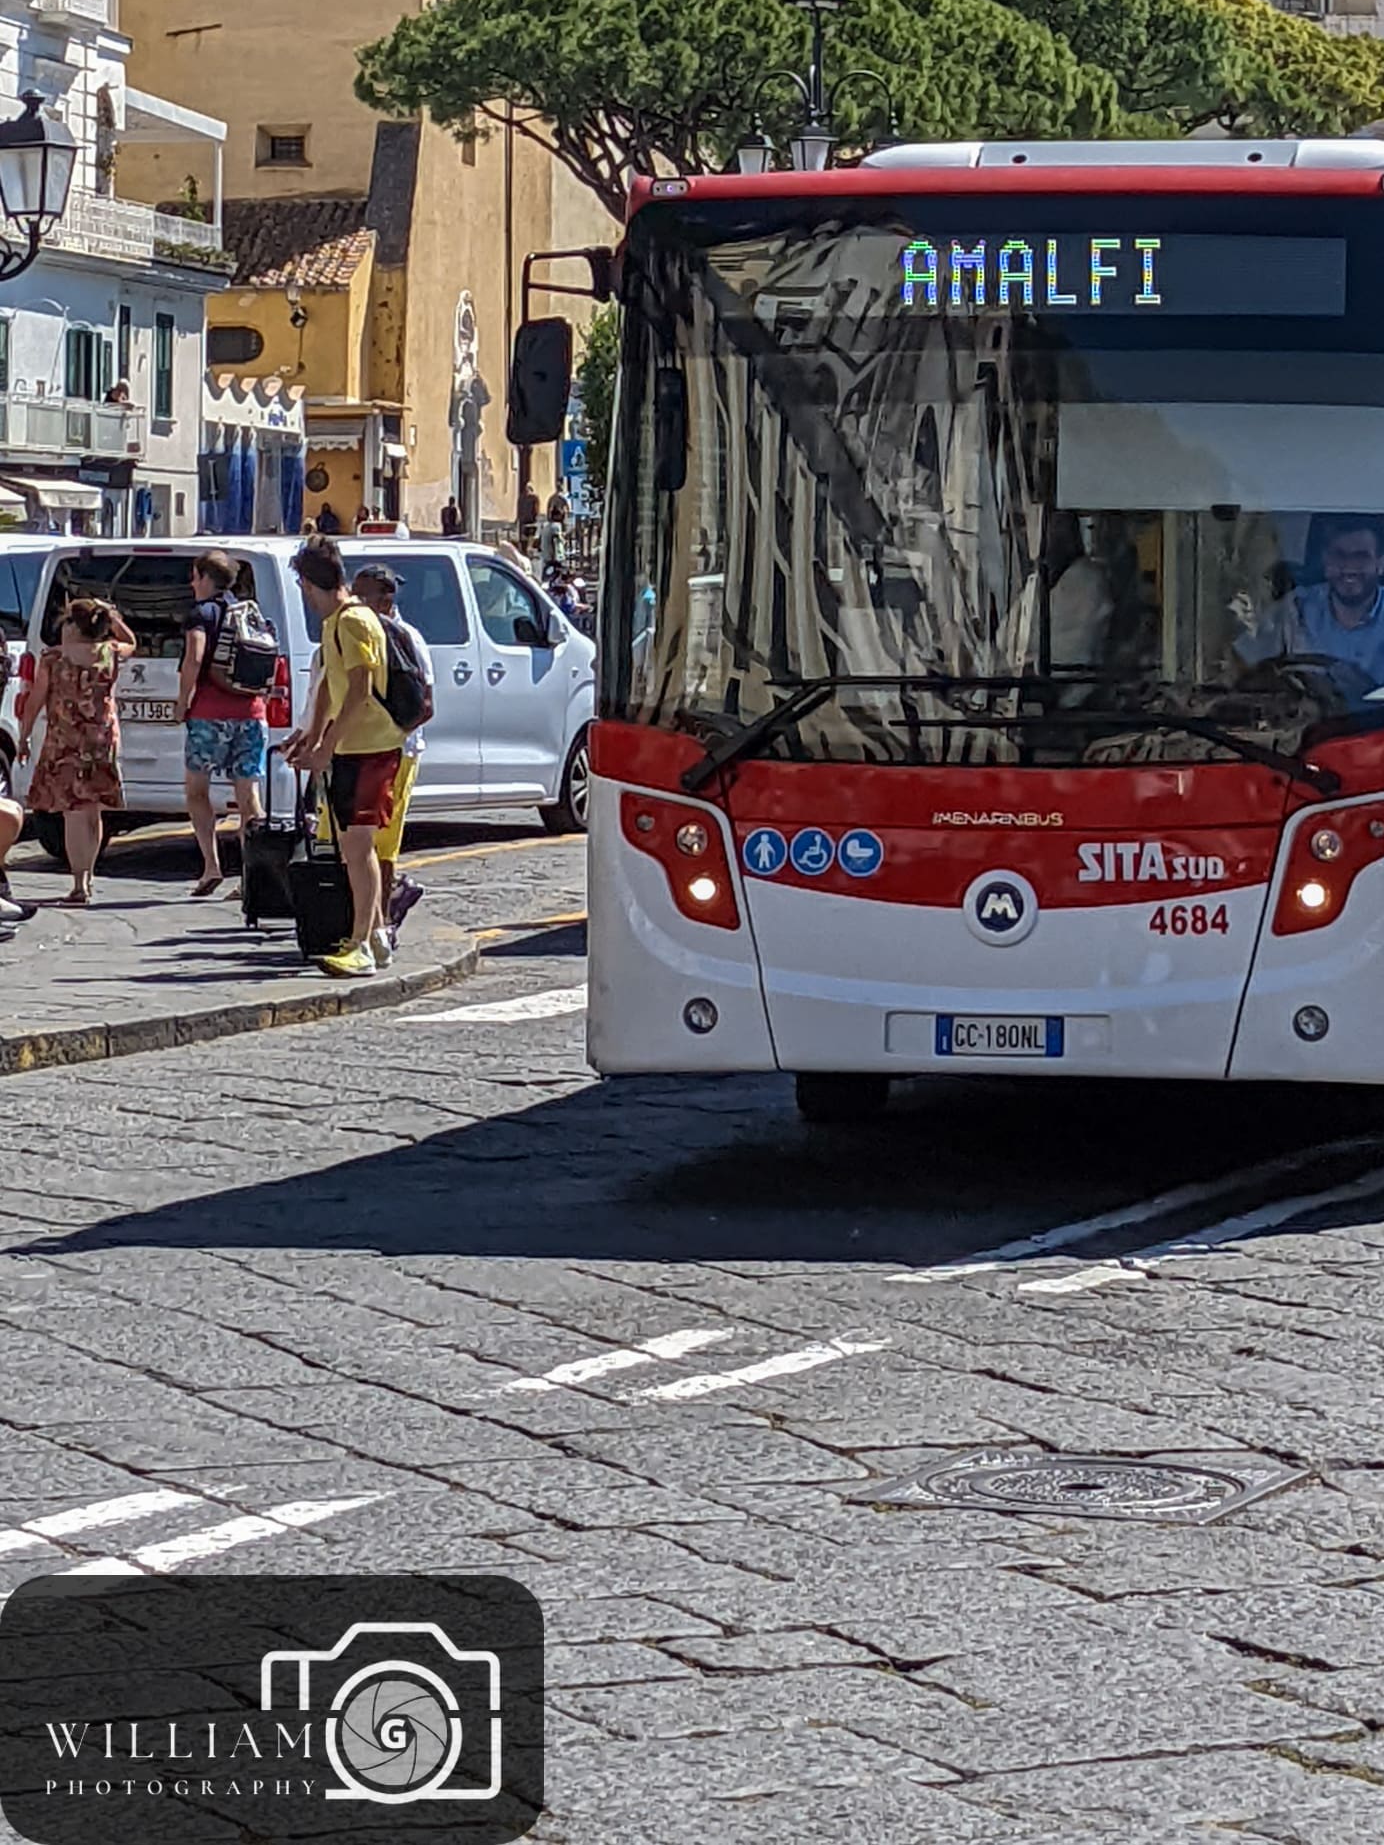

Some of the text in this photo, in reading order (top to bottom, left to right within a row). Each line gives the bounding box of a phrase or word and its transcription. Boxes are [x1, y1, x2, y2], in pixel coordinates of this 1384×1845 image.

[902, 238, 1161, 305] AMALFI
[1077, 841, 1225, 882] SITA SUD
[1149, 904, 1230, 936] 4684
